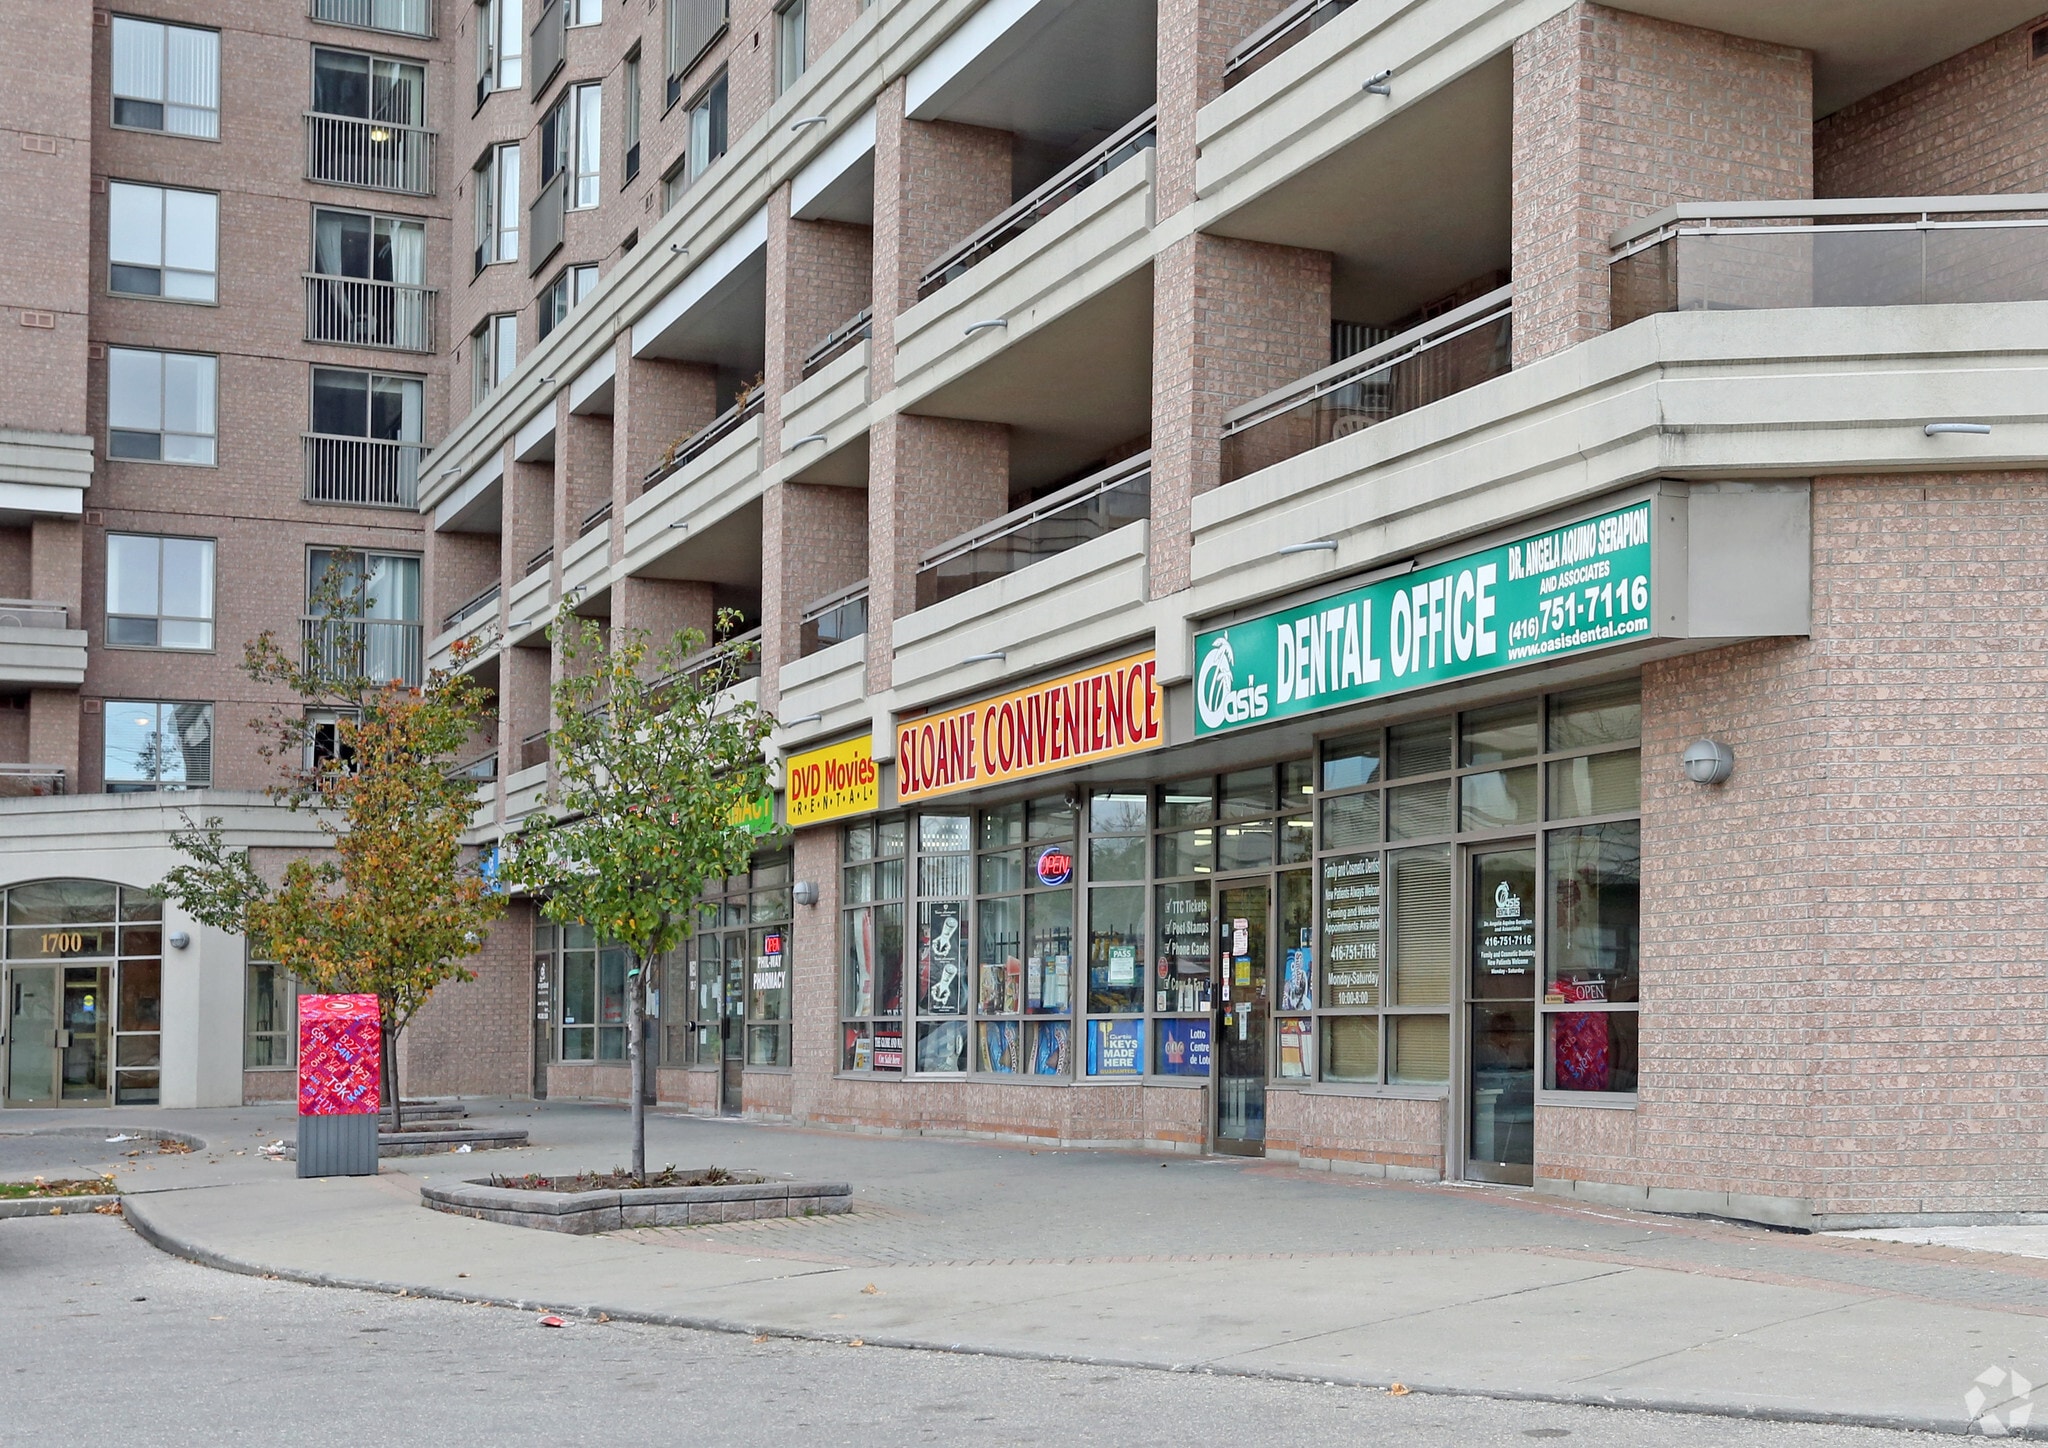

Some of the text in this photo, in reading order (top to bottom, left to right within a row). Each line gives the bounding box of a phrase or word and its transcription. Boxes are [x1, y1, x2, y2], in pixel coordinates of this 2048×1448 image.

[1509, 507, 1648, 582] DR. ANGELA AQUINO SERAPION
[1540, 560, 1610, 595] AND ASSOCIATES
[1509, 575, 1648, 646] (416) 751-7116
[1277, 562, 1497, 704] DENTAL OFFICE
[1508, 617, 1648, 660] www.oasisdental.com
[1199, 631, 1269, 728] Oasis
[900, 660, 1159, 796] SLOANE CONVENIENCE
[792, 751, 875, 801] DVD Movies
[1040, 855, 1070, 875] OPEN
[1495, 881, 1520, 908] Oasis
[1173, 899, 1208, 914] TTC Tickets
[1172, 920, 1209, 936] Post Stamps
[41, 932, 82, 953] 1700
[766, 937, 780, 952] OPEN
[1171, 941, 1209, 956] Phone Cards
[1485, 935, 1532, 947] 416-751-7116
[1113, 950, 1131, 958] PASS
[1331, 943, 1377, 961] 416-751-7116
[753, 971, 786, 990] PHARMACY
[1576, 984, 1605, 1000] OPEN
[1190, 1029, 1206, 1039] Lotto
[332, 1042, 353, 1061] S4N
[339, 1034, 361, 1055] B2Z
[1103, 1049, 1135, 1058] MADE
[1110, 1040, 1138, 1049] KEYS
[1190, 1041, 1210, 1052] Centre
[1103, 1058, 1134, 1067] HERE
[1190, 1054, 1198, 1065] de
[327, 1075, 350, 1100] T9K
[347, 1084, 367, 1102] K4A
[314, 1093, 336, 1113] H1X
